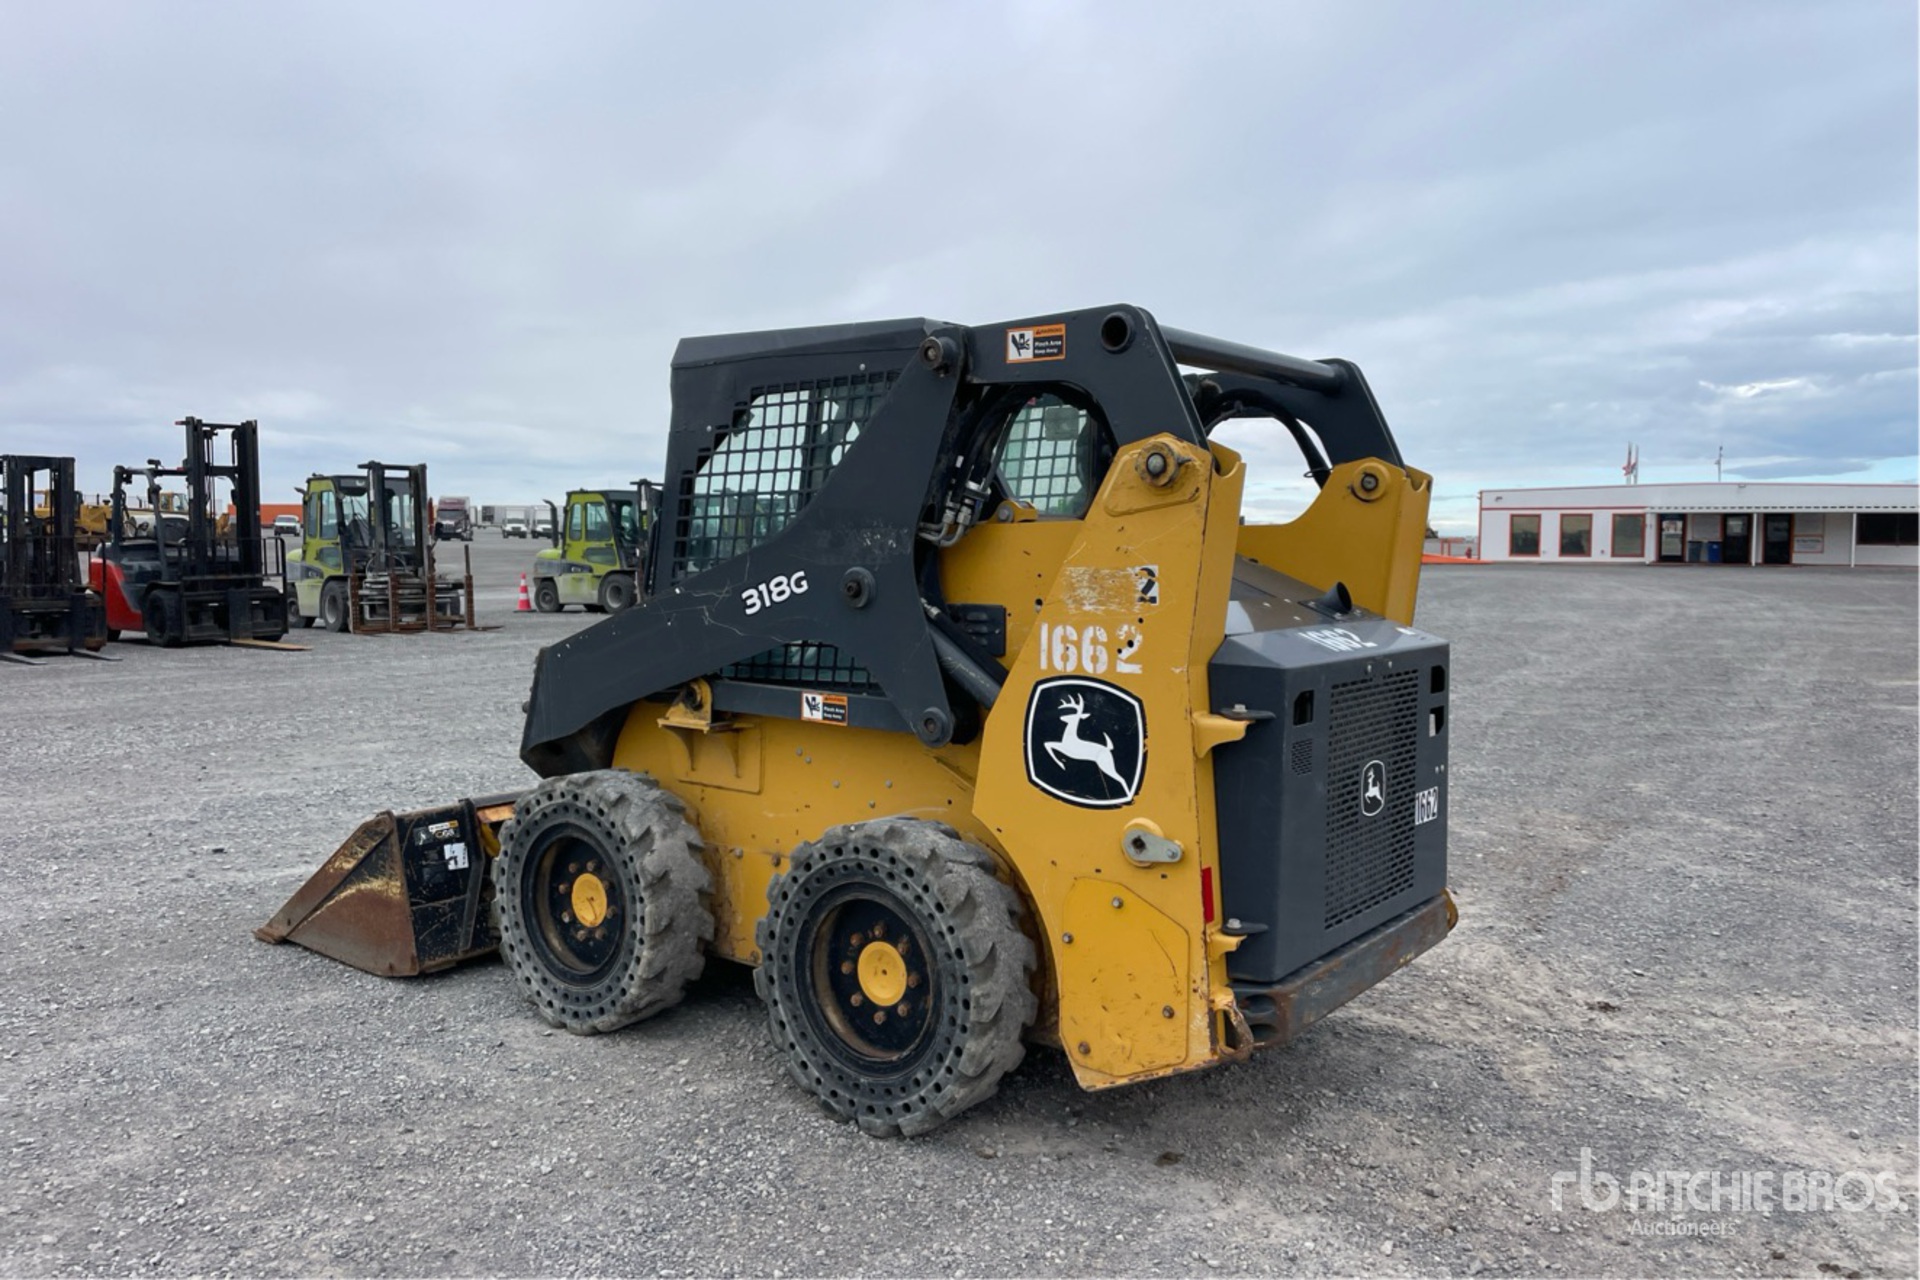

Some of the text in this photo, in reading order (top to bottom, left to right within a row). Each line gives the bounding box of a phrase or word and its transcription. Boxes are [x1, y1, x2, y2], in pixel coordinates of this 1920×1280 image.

[741, 570, 809, 616] 318G
[1040, 622, 1144, 675] 1662
[1415, 786, 1438, 825] 1662
